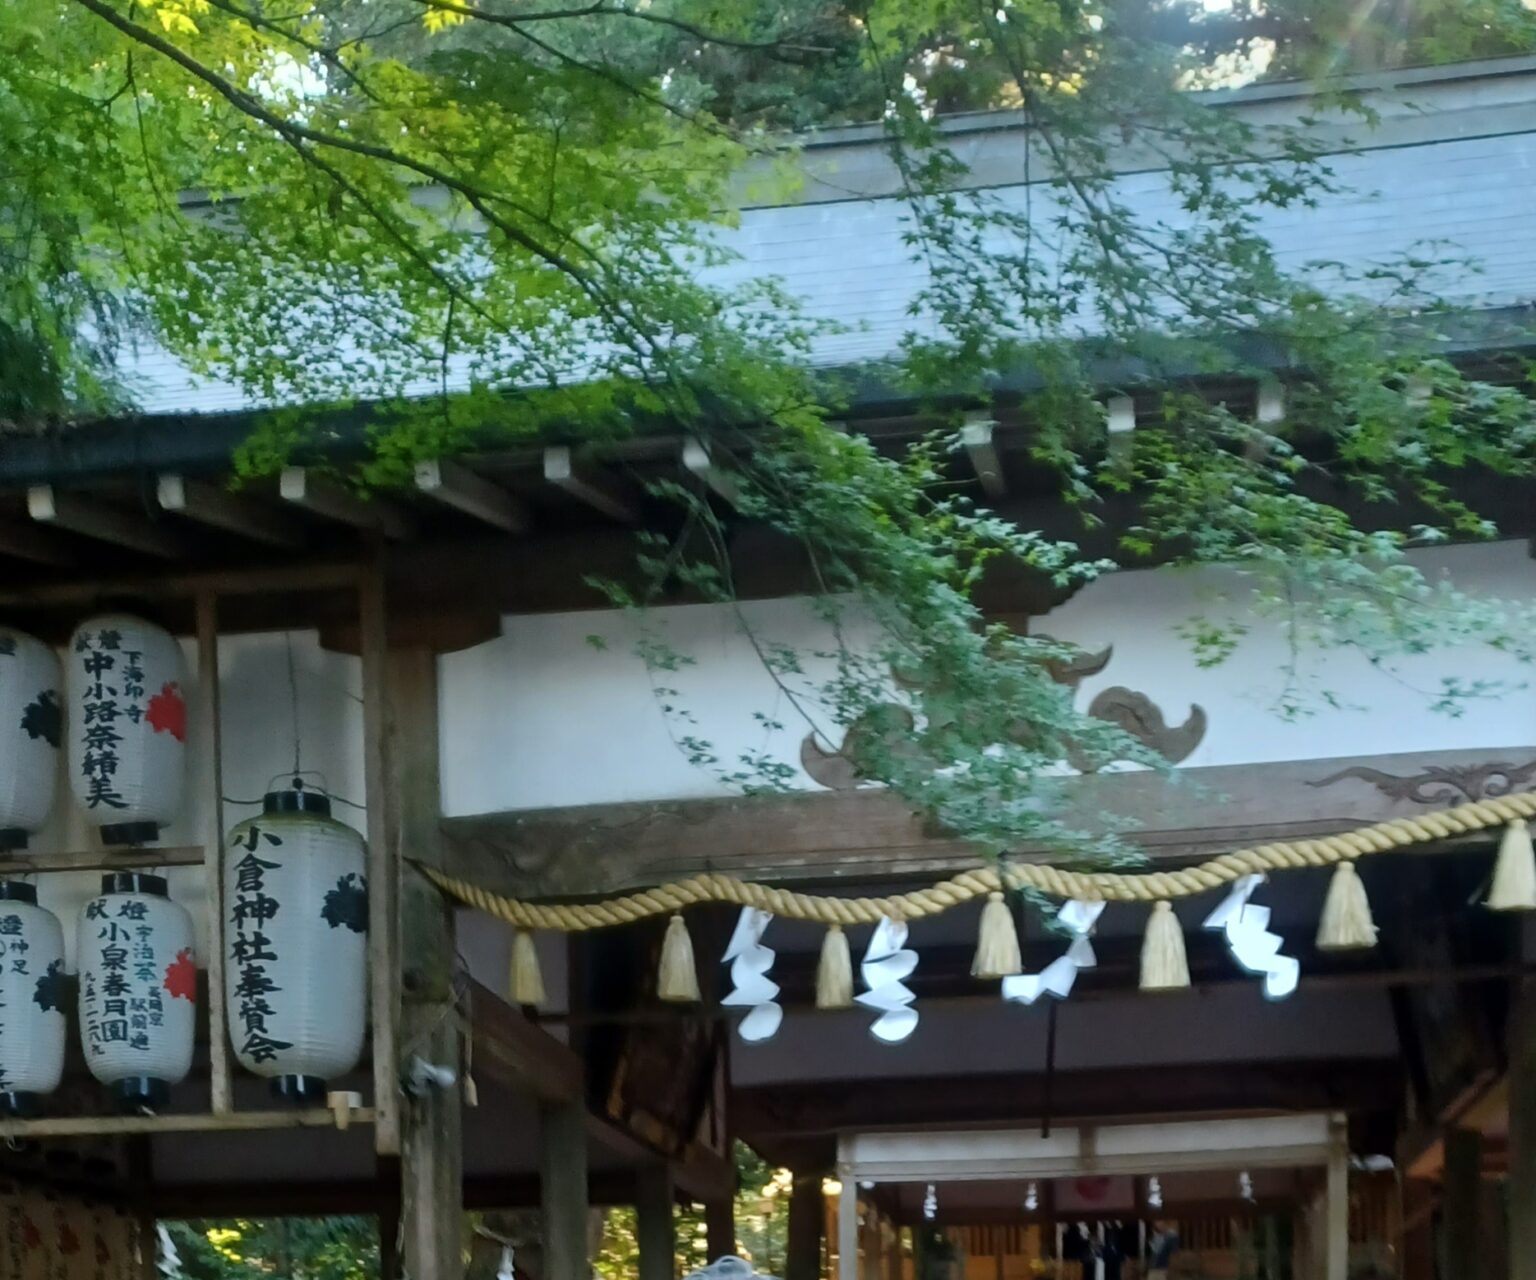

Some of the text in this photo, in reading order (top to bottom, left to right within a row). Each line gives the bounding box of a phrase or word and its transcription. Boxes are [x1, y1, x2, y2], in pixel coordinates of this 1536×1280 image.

[81, 651, 130, 809] 中小路奈緒美
[122, 650, 145, 724] 下海印寺
[9, 938, 30, 976] 神足
[98, 921, 132, 1042] 小泉春月園
[134, 924, 157, 982] 宇治茶
[229, 826, 294, 1064] 小倉神社奉賛会
